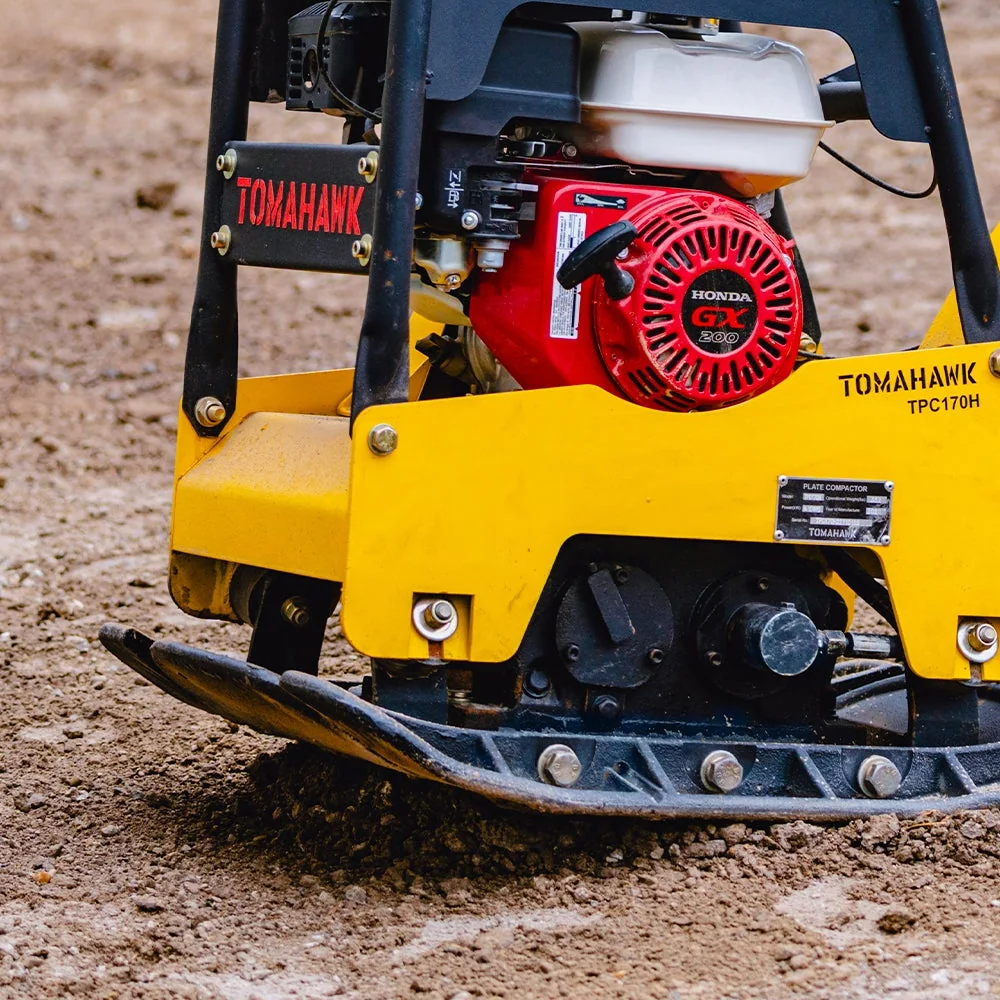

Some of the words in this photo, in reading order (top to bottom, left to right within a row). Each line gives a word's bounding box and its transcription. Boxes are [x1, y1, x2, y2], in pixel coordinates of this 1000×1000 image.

[237, 177, 365, 235] TOMAHAWK
[691, 290, 753, 302] HONDA
[691, 305, 749, 329] GX
[699, 331, 739, 343] 200
[838, 362, 977, 397] TOMAHAWK
[907, 394, 980, 415] TPC170H
[803, 483, 825, 491] PLATE
[825, 484, 868, 493] COMPACTOR
